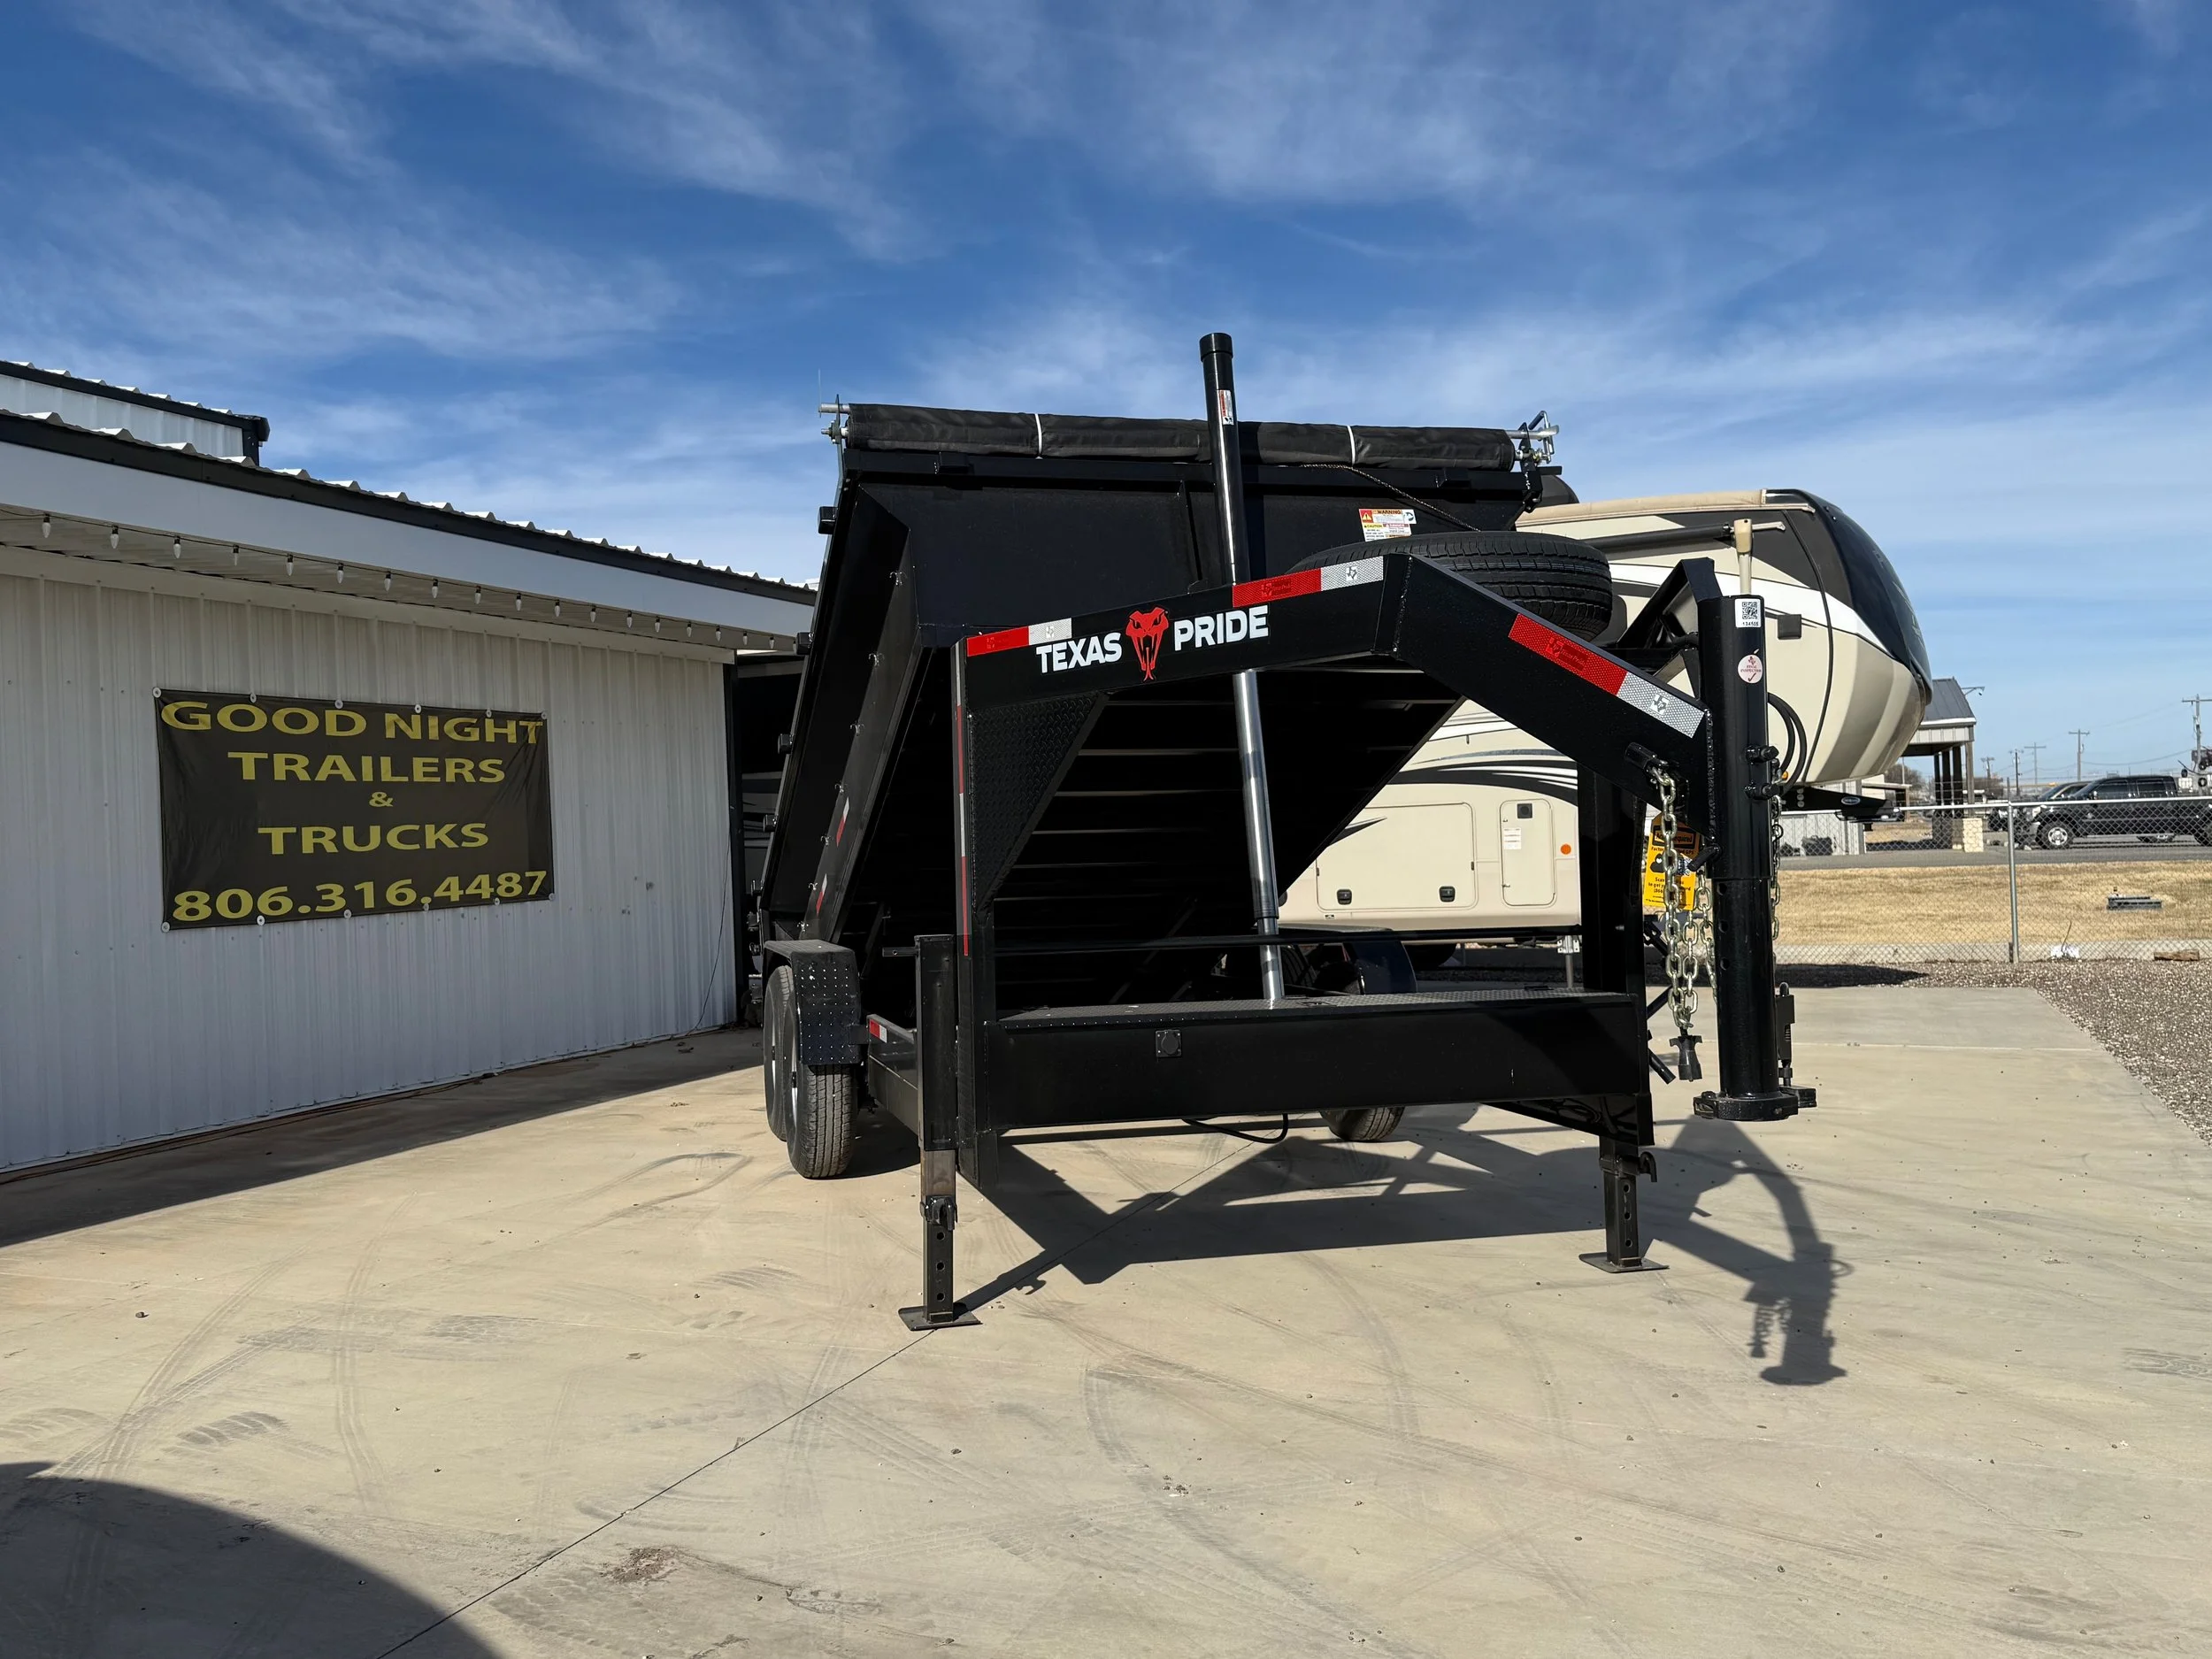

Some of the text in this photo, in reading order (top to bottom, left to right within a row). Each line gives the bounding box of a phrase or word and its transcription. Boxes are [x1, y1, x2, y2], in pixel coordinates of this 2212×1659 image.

[1035, 605, 1269, 673] TEXAS PRIDE
[161, 701, 543, 744] GOOD NIGHT
[227, 752, 505, 784] TRAILERS
[368, 791, 394, 807] &
[257, 823, 488, 855] TRUCKS
[173, 871, 547, 922] 806.316.4487
